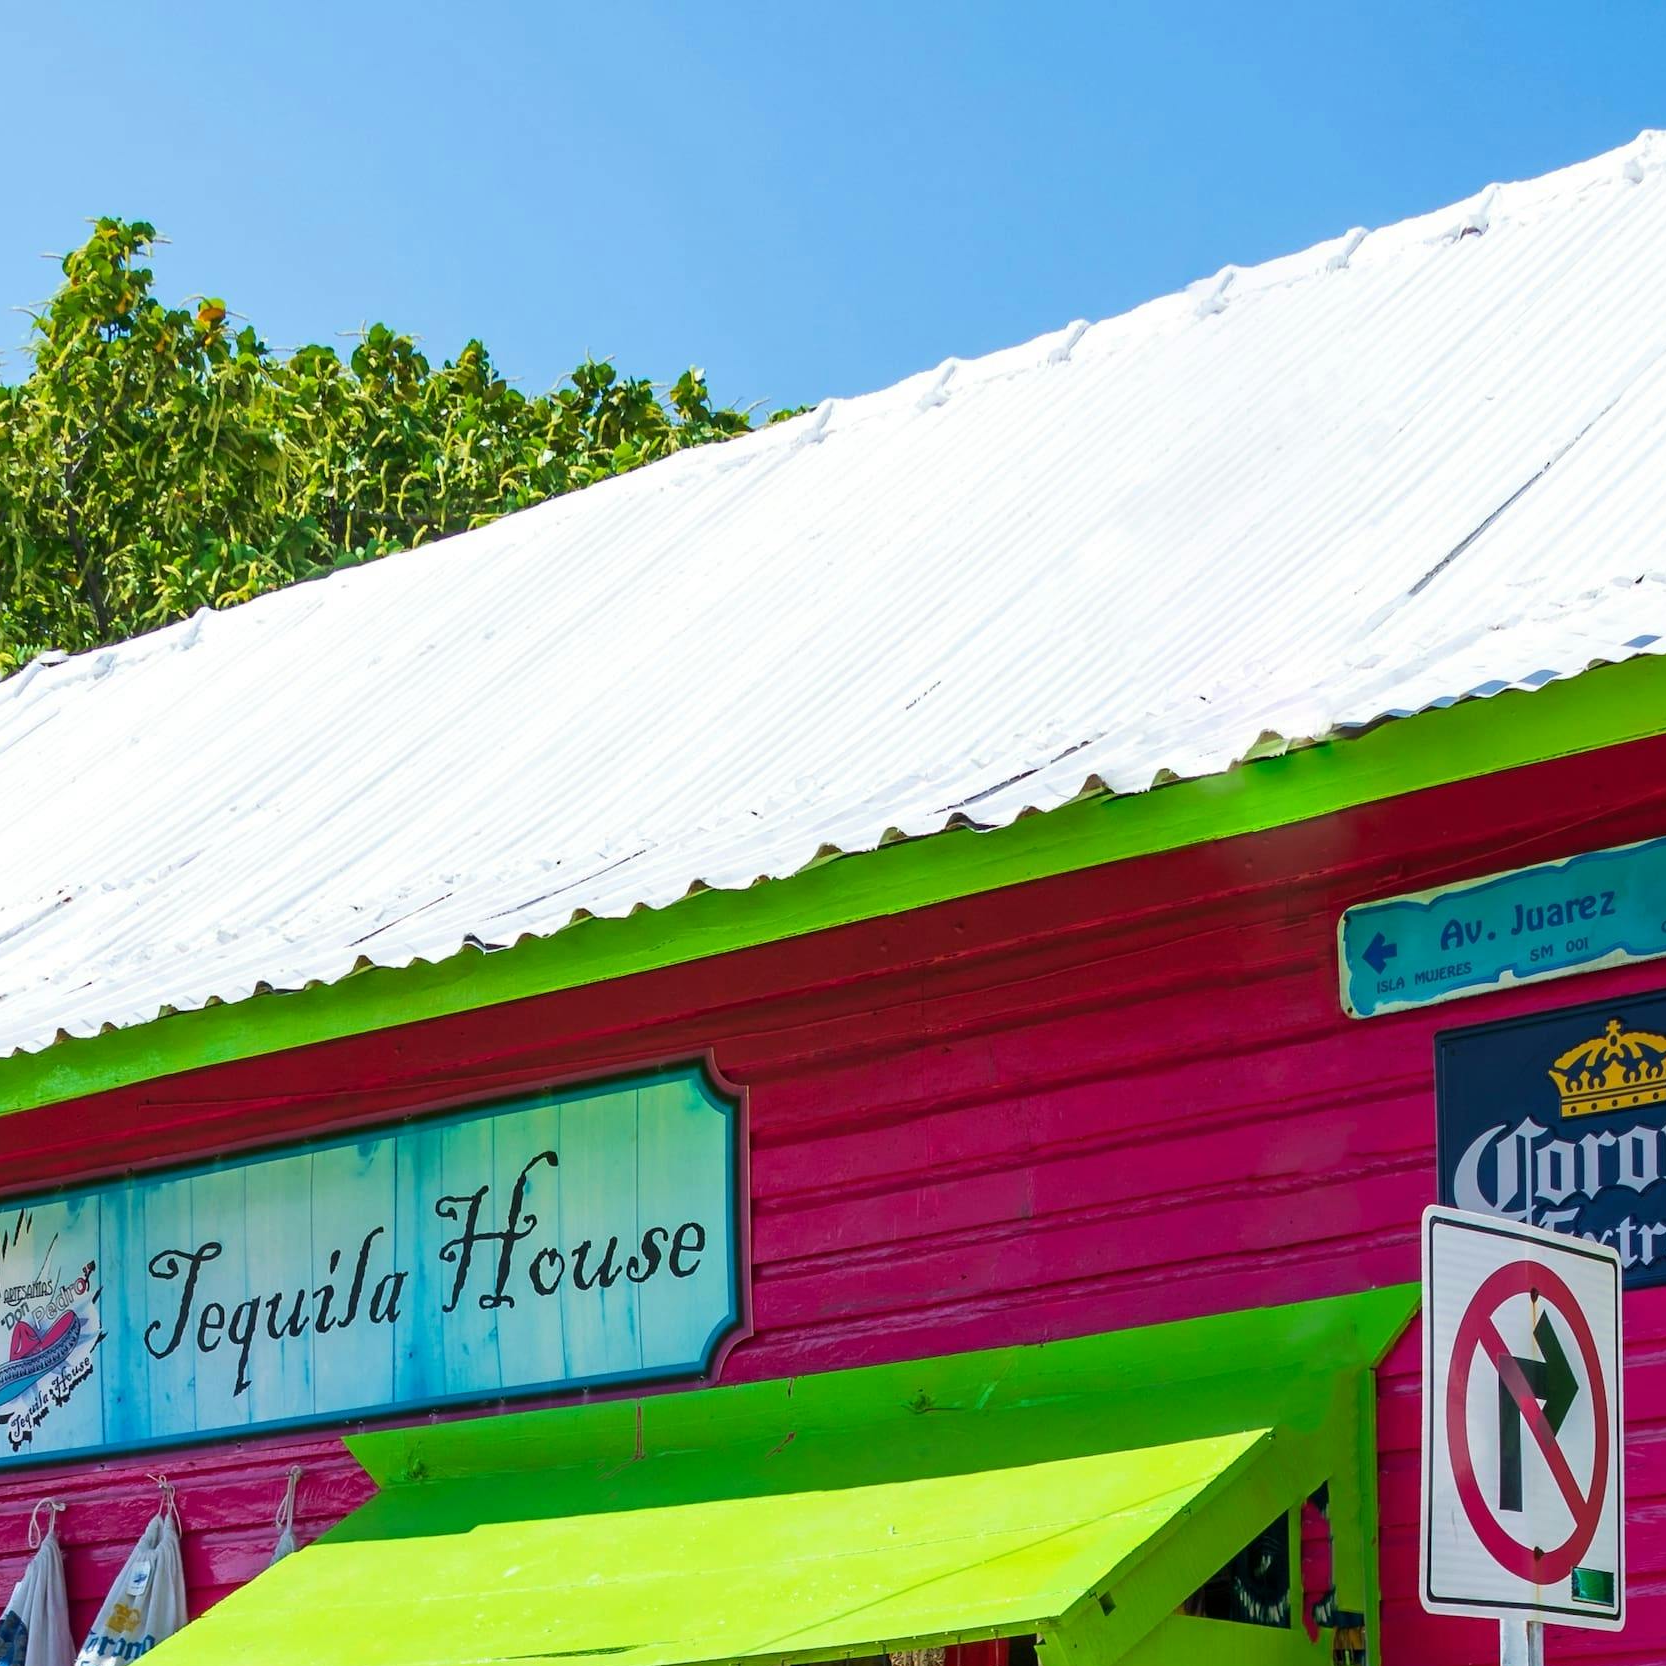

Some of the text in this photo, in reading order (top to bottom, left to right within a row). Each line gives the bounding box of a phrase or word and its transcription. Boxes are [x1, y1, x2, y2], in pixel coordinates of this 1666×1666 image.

[1441, 890, 1616, 950] Av. Juarez
[1530, 944, 1554, 962] SM
[1376, 962, 1472, 994] ISLA MUJERES
[3, 1280, 54, 1306] ARTESANIAS
[145, 1149, 707, 1395] Tequila House
[10, 1357, 91, 1437] Tequila House
